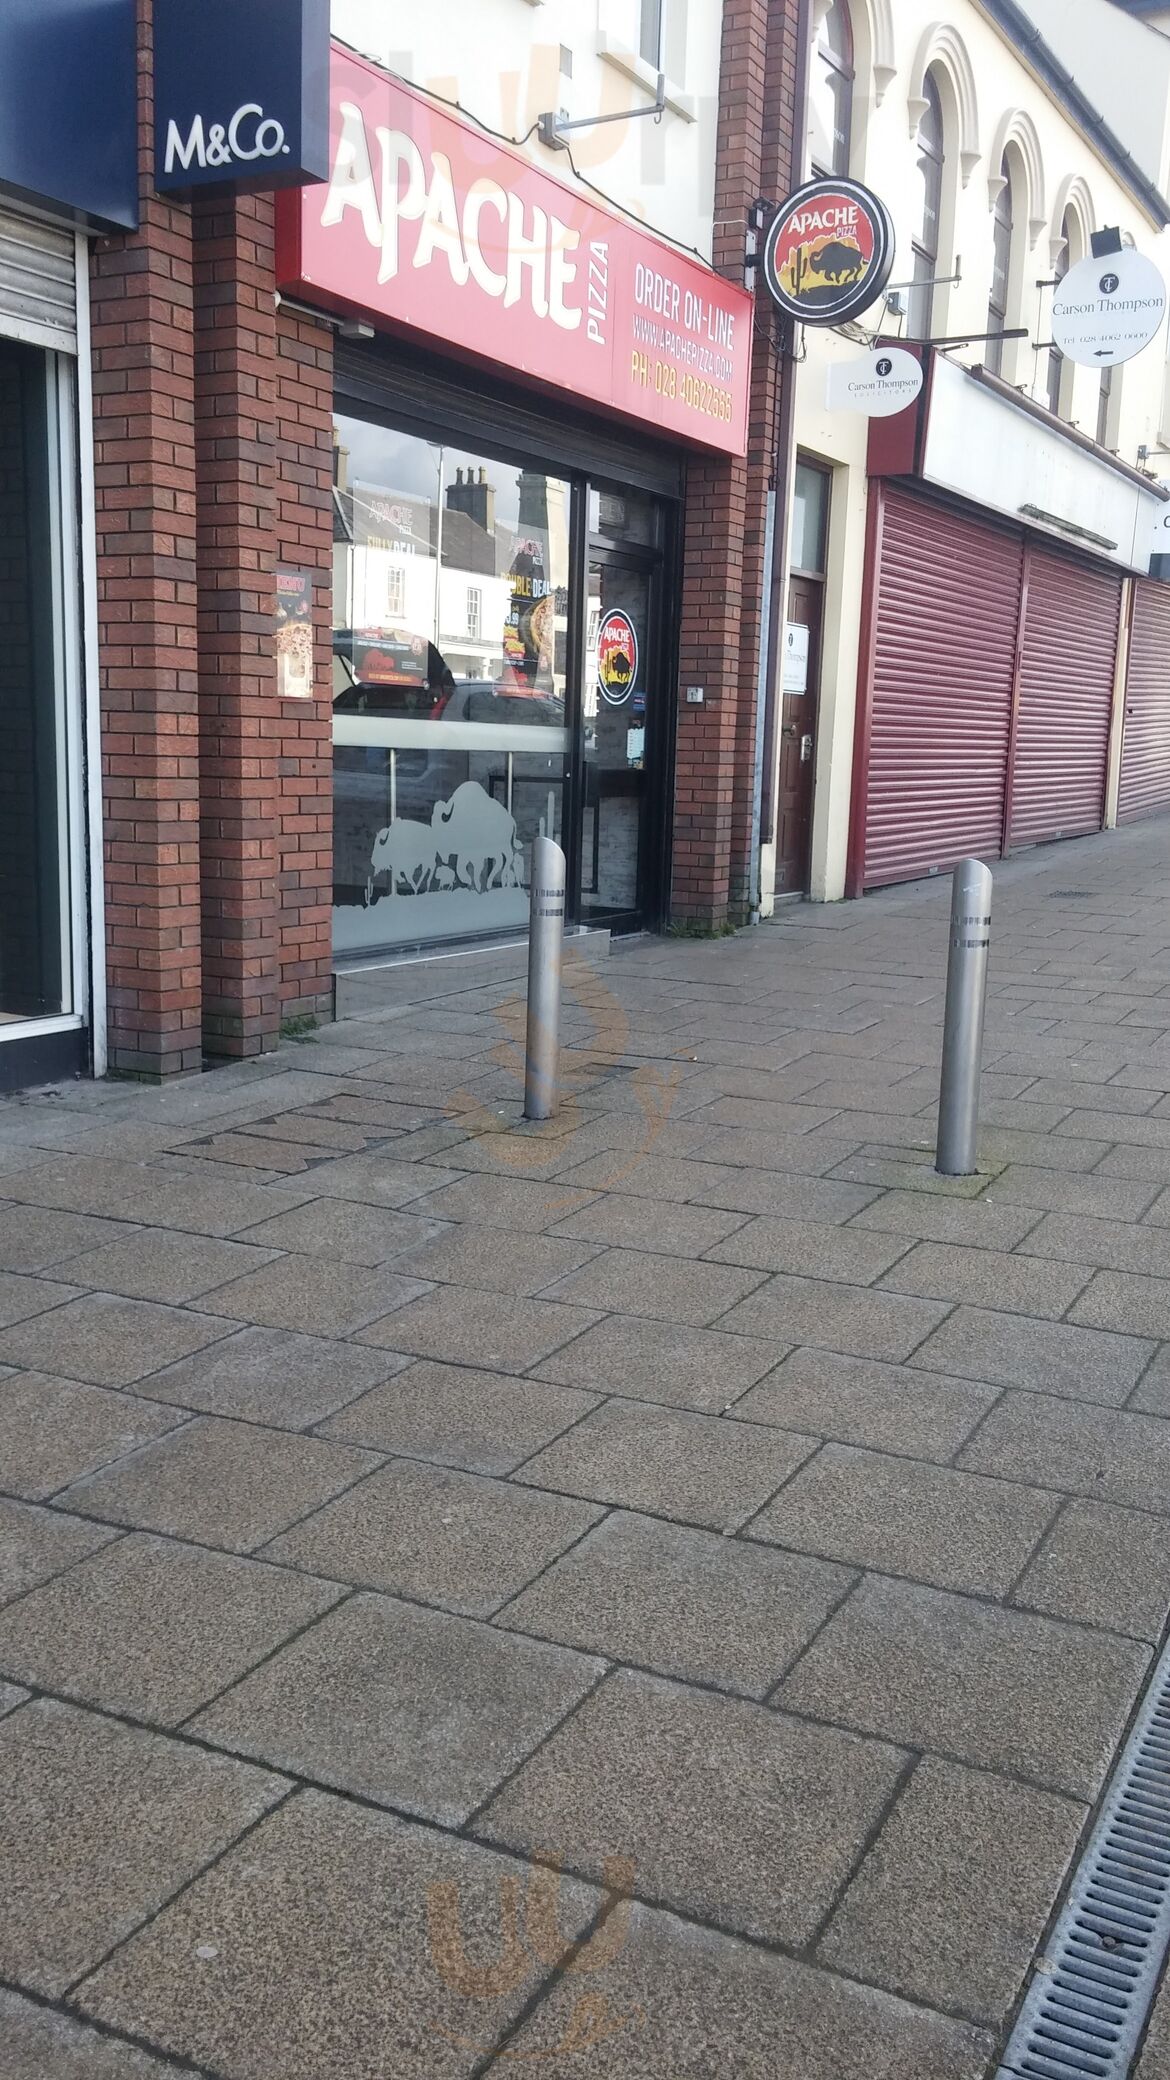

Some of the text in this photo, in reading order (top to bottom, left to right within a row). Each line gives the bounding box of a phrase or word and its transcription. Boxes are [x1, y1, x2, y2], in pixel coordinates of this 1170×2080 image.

[164, 103, 291, 173] M&Co.
[320, 101, 583, 331] APACHE
[787, 206, 859, 235] APACHE
[836, 225, 858, 238] PIZZA
[587, 241, 609, 345] PIZZA
[634, 262, 735, 351] ORDER ON-LINE
[1052, 297, 1163, 316] Carson Thompson
[632, 313, 733, 382] WWW.APACHEPIZZA.COM
[655, 360, 677, 400] 028
[848, 379, 918, 391] Carson Thompson
[532, 578, 551, 599] DEAL
[604, 626, 630, 643] APACHE
